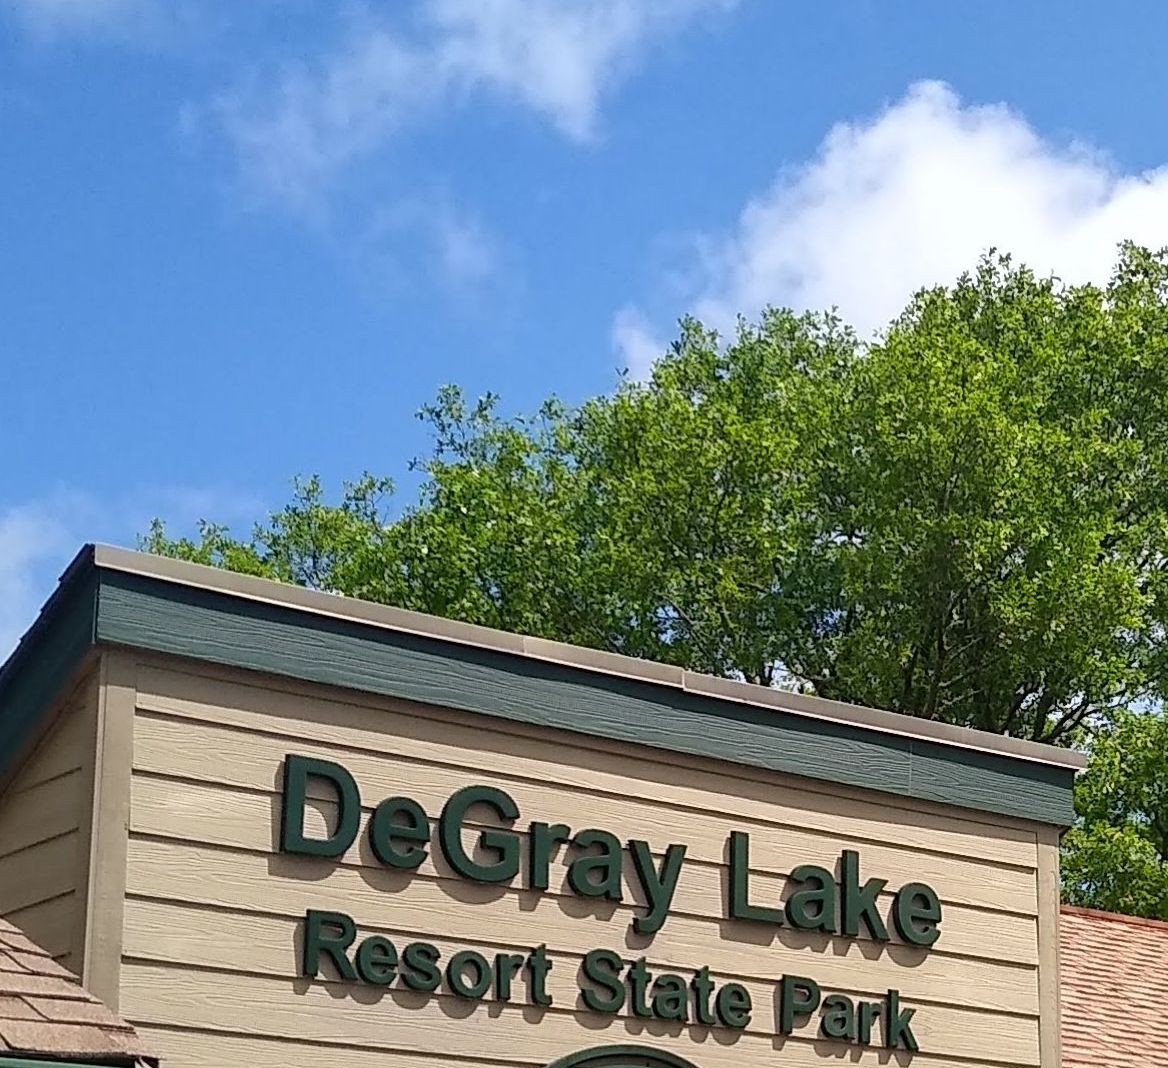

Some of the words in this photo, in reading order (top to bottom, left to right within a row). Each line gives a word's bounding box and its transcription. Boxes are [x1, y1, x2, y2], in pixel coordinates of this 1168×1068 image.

[281, 753, 686, 934] DeGray
[729, 832, 942, 946] Lake
[304, 909, 552, 1005] Resort
[580, 948, 752, 1031] State
[779, 973, 919, 1053] Park
